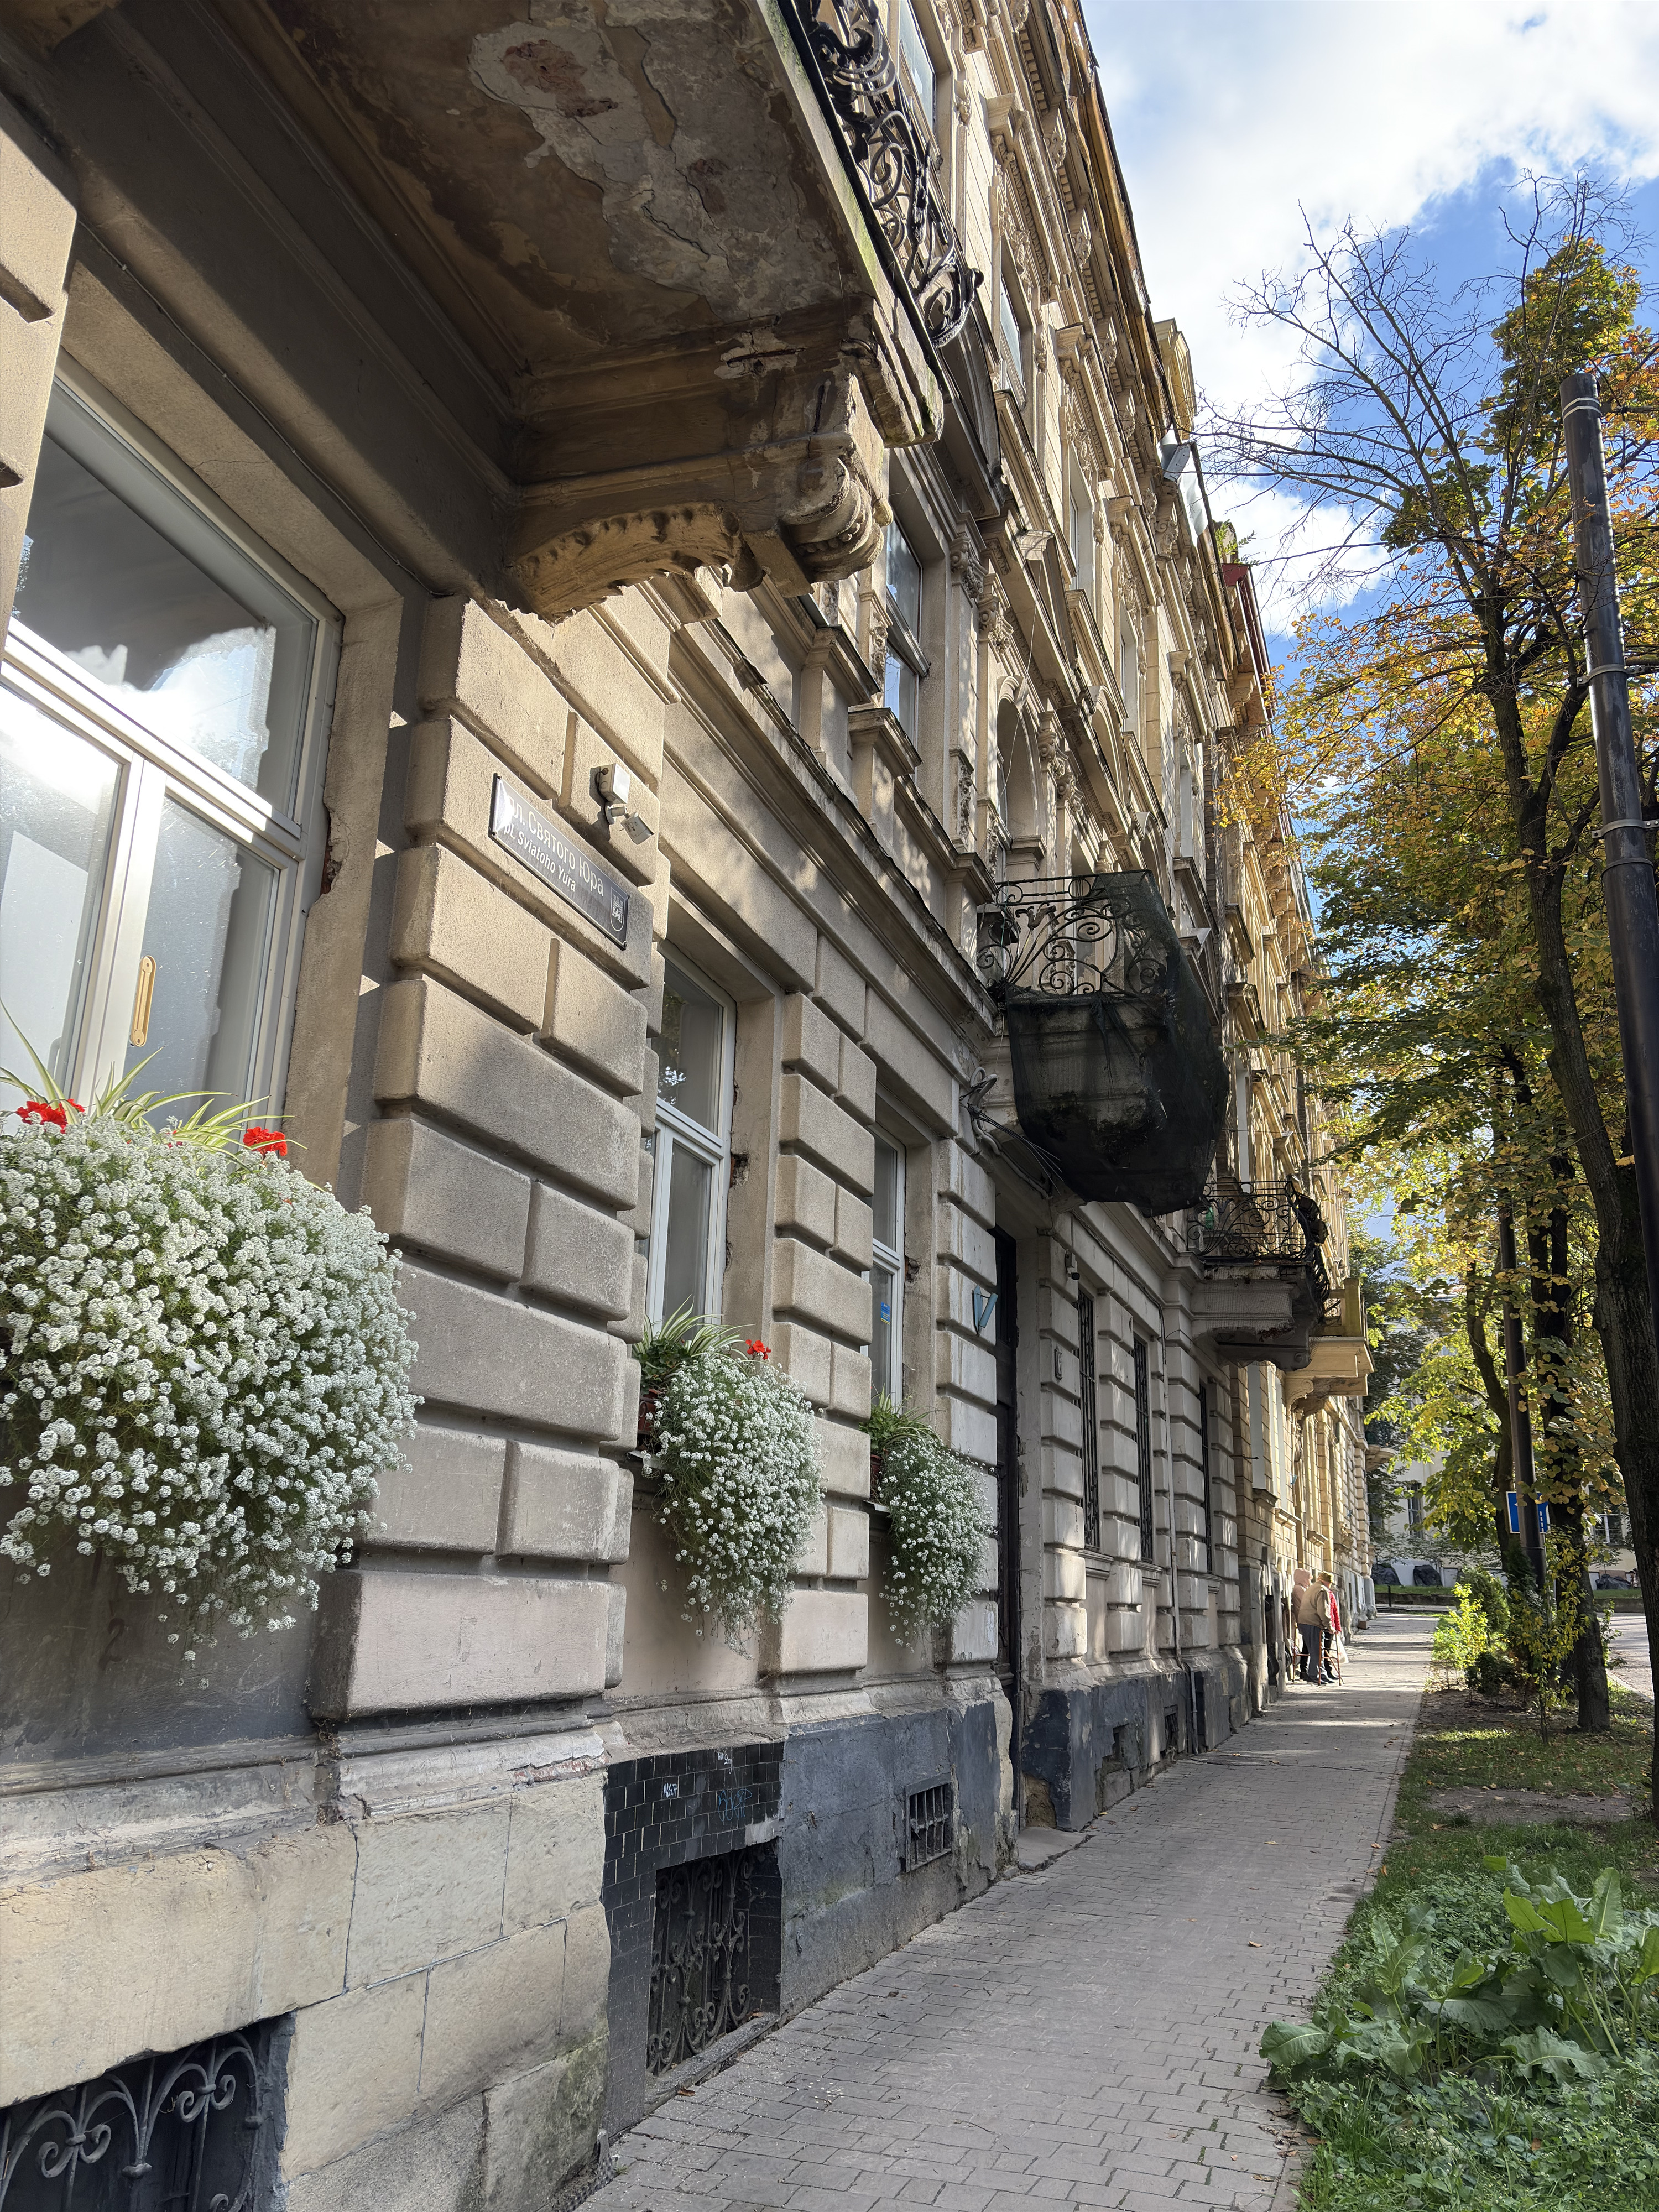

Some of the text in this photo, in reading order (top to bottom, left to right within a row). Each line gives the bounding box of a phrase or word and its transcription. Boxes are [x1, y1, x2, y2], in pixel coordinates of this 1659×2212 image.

[504, 823, 576, 892] pl. Sviatoho Yura
[529, 811, 576, 870] Святого
[580, 856, 604, 897] Юра
